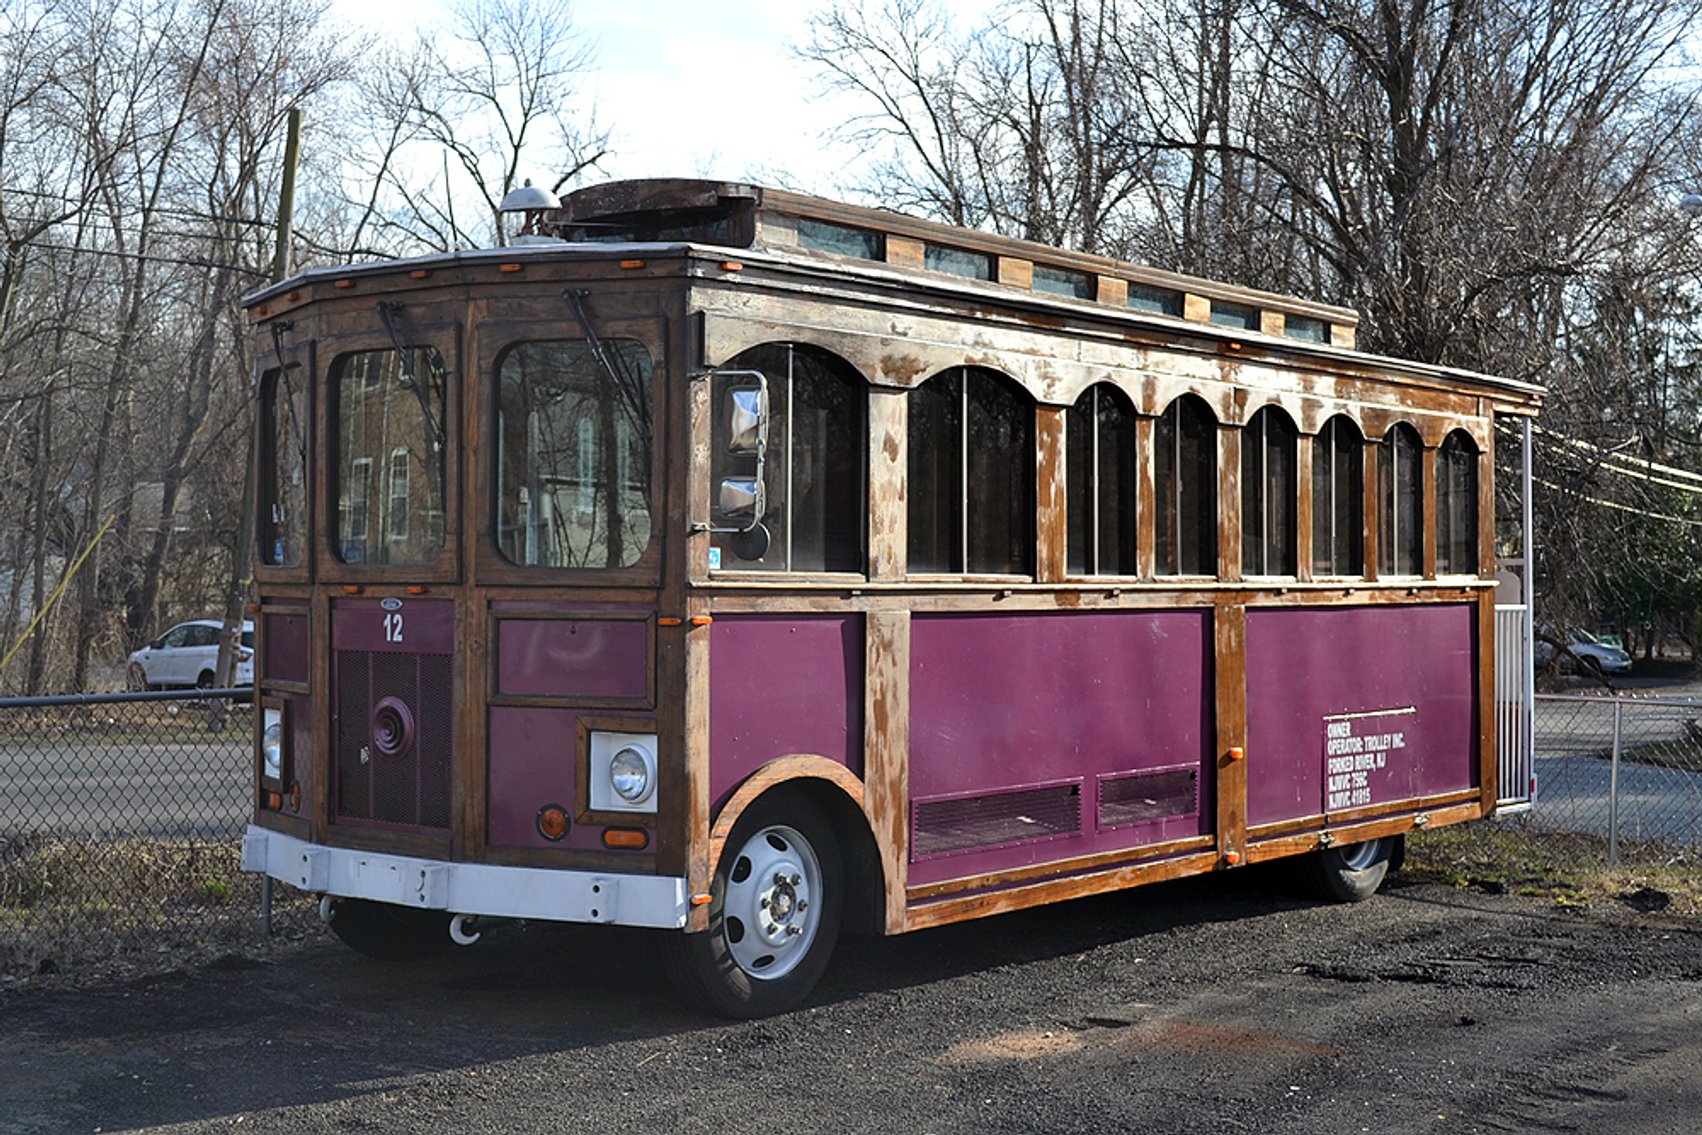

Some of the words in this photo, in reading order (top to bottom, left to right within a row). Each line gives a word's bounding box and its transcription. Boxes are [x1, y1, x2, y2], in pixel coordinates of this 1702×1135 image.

[383, 614, 403, 641] 12
[1328, 721, 1351, 738] OWNER
[1364, 734, 1391, 751] TROLLEY
[1392, 732, 1405, 748] INC.
[1328, 756, 1354, 774] FORKED
